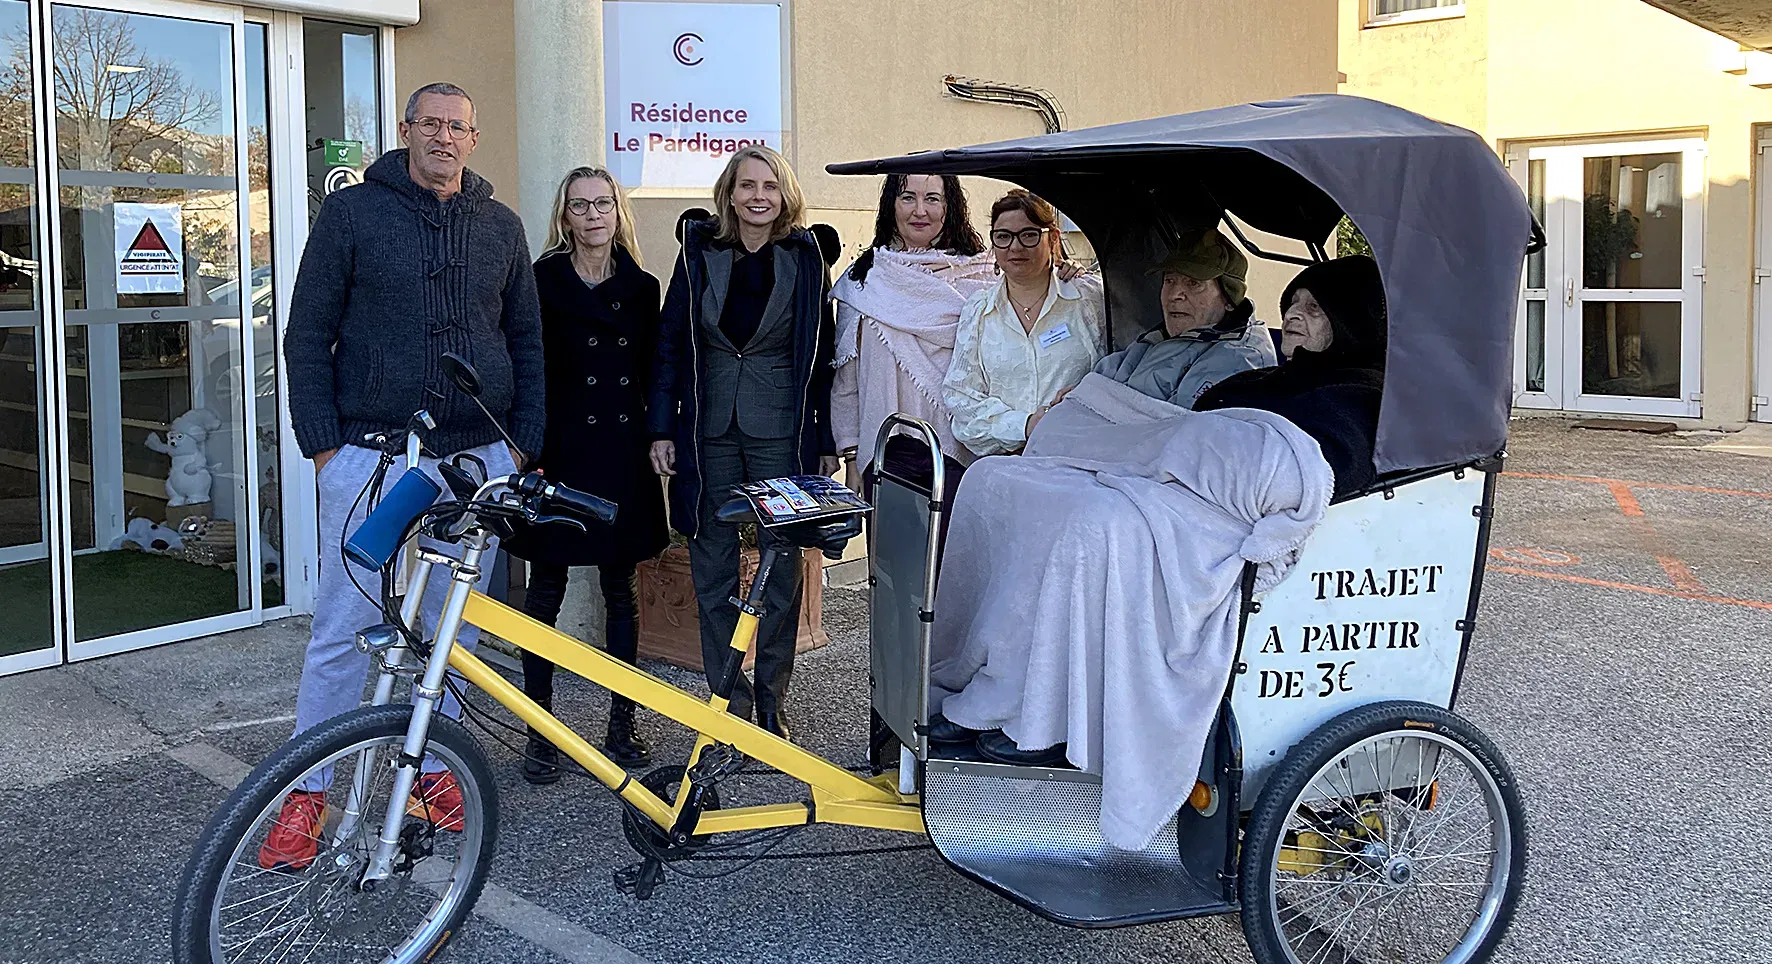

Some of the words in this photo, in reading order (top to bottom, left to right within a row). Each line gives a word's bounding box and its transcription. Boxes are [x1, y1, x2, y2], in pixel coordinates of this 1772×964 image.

[631, 102, 748, 123] Résidence
[613, 132, 640, 152] Le
[1311, 565, 1443, 600] TRAJET
[1260, 626, 1285, 654] A
[1300, 621, 1420, 653] PARTIR
[1258, 670, 1304, 699] DE
[1316, 660, 1356, 698] 3€
